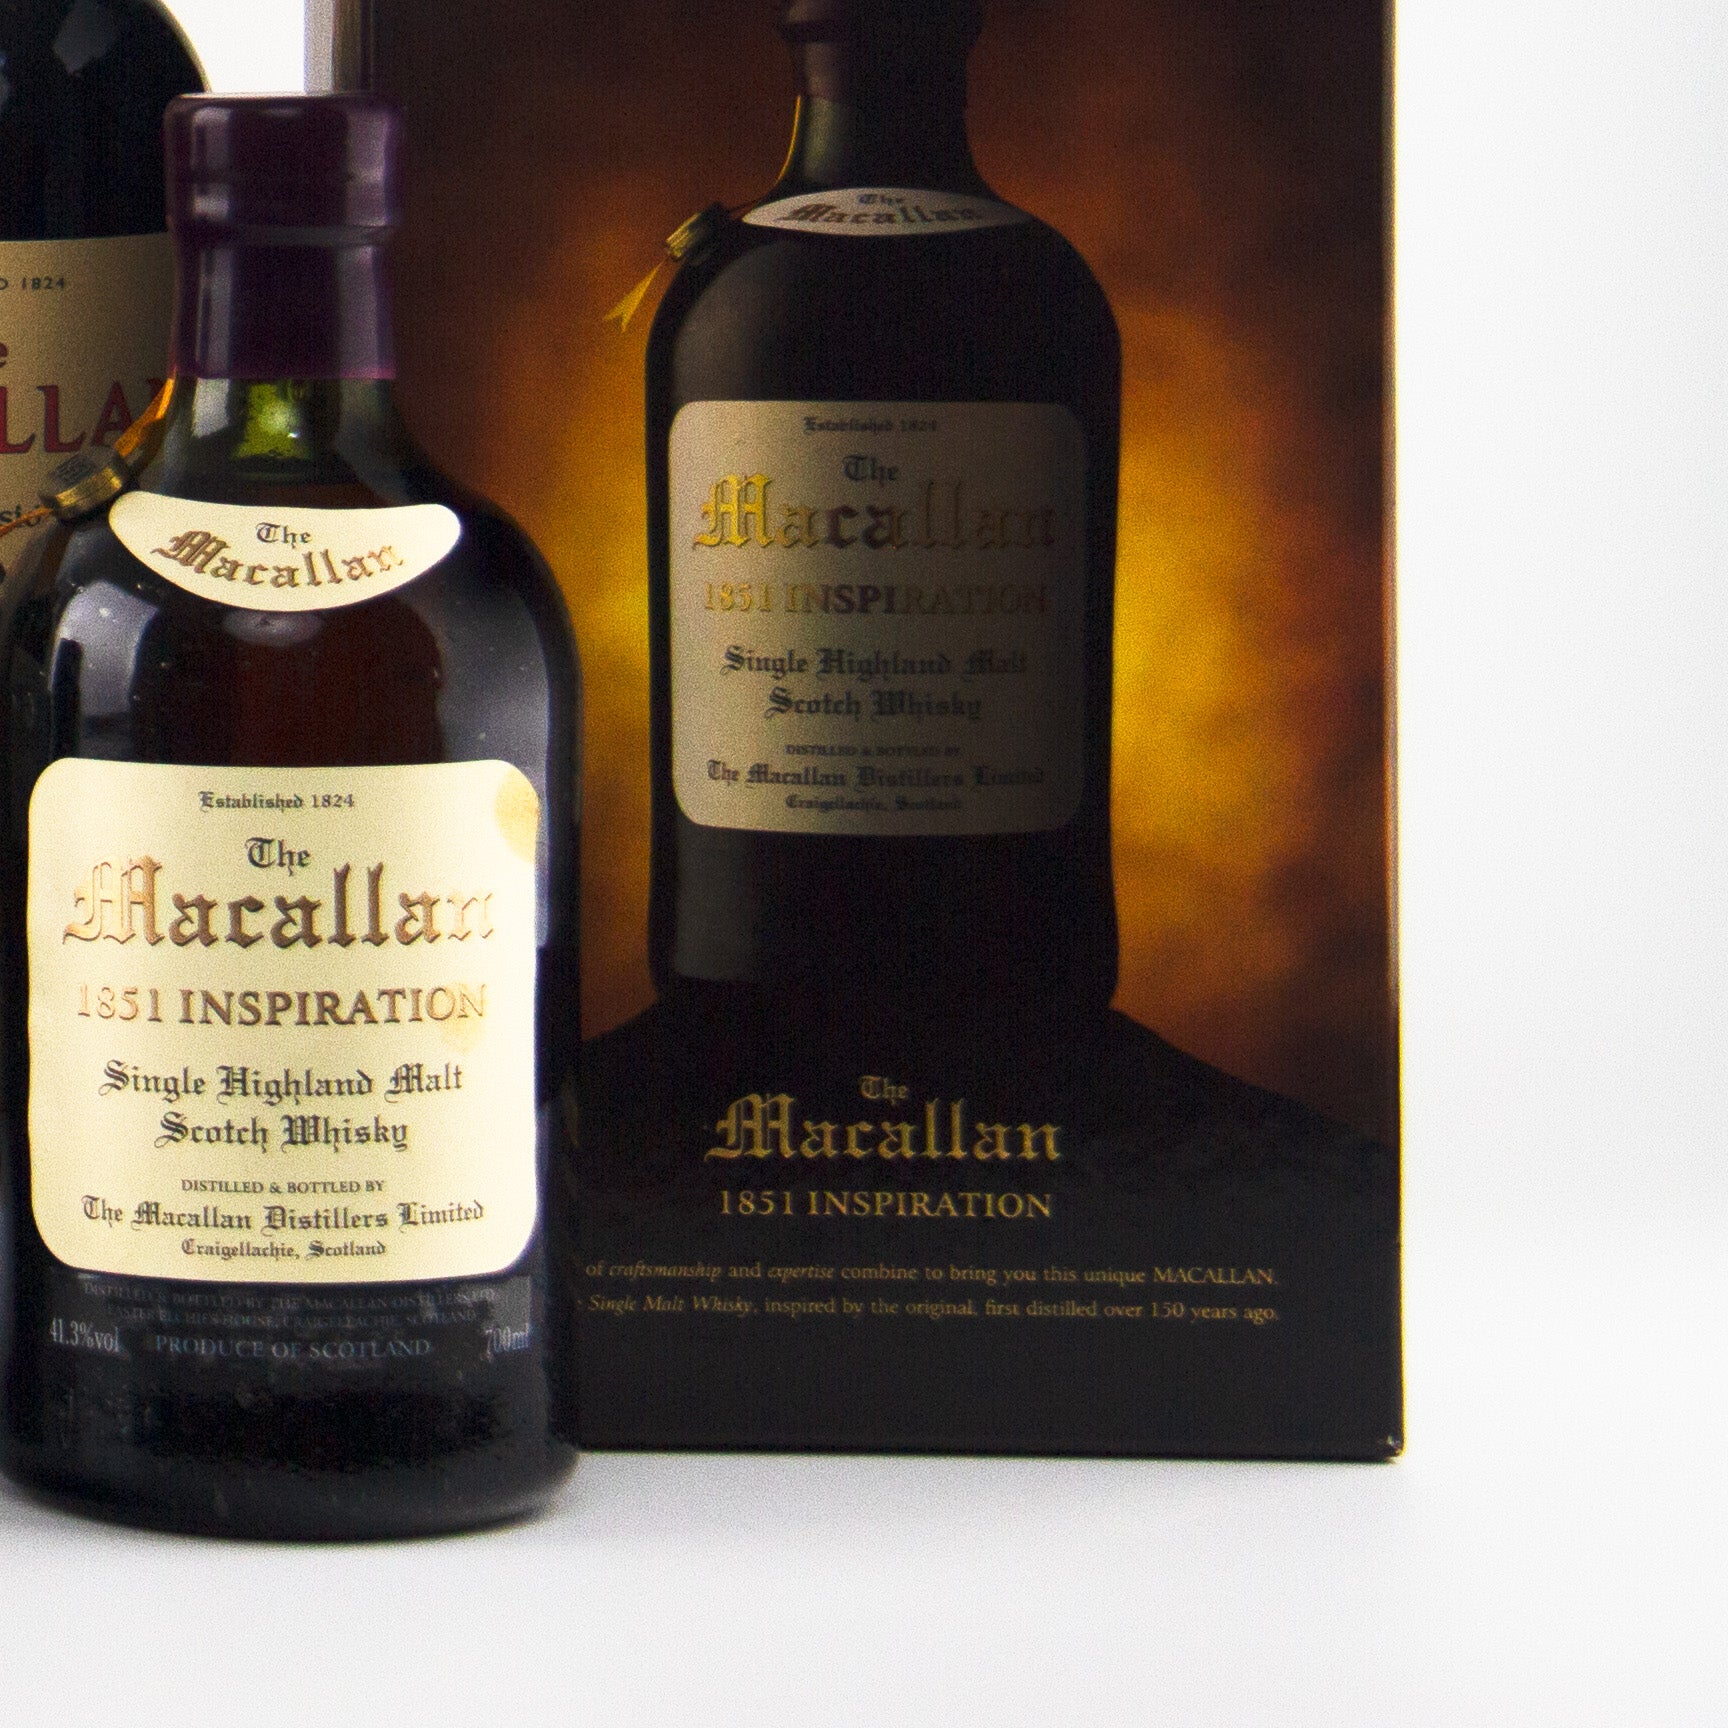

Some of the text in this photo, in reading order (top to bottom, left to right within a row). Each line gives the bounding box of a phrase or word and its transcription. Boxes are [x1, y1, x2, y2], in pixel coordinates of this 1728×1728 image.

[21, 275, 67, 292] 1824
[842, 454, 900, 488] The
[692, 472, 1056, 552] Macallan
[254, 521, 313, 550] The
[149, 530, 405, 589] Macallan
[704, 581, 1048, 615] 1851 INSPIRATION
[719, 643, 809, 681] Single
[816, 646, 952, 683] Highland
[764, 685, 983, 724] Scotch Whisky
[198, 790, 357, 814] Established 1824
[244, 836, 313, 877] The
[62, 854, 496, 950] Macallan
[76, 983, 490, 1027] 1851 INSPIRATION
[97, 1058, 465, 1107] Single Highland Malt
[860, 1075, 909, 1106] The
[153, 1110, 410, 1155] Scotch Whisky
[704, 1092, 1063, 1163] Macallan
[180, 1178, 386, 1195] DISTILLED & BOTTLED BY
[80, 1193, 486, 1238] The Macallan Distillers Limited
[720, 1189, 1053, 1220] 1851 INSPIRATION
[179, 1237, 388, 1262] Craigellachie, Scotland
[728, 1262, 1147, 1288] and combine bring you unique
[588, 1294, 1238, 1325] Single Malt inspired distilled over 150 years
[154, 1333, 434, 1359] PRODUCE OF SCOTLAND
